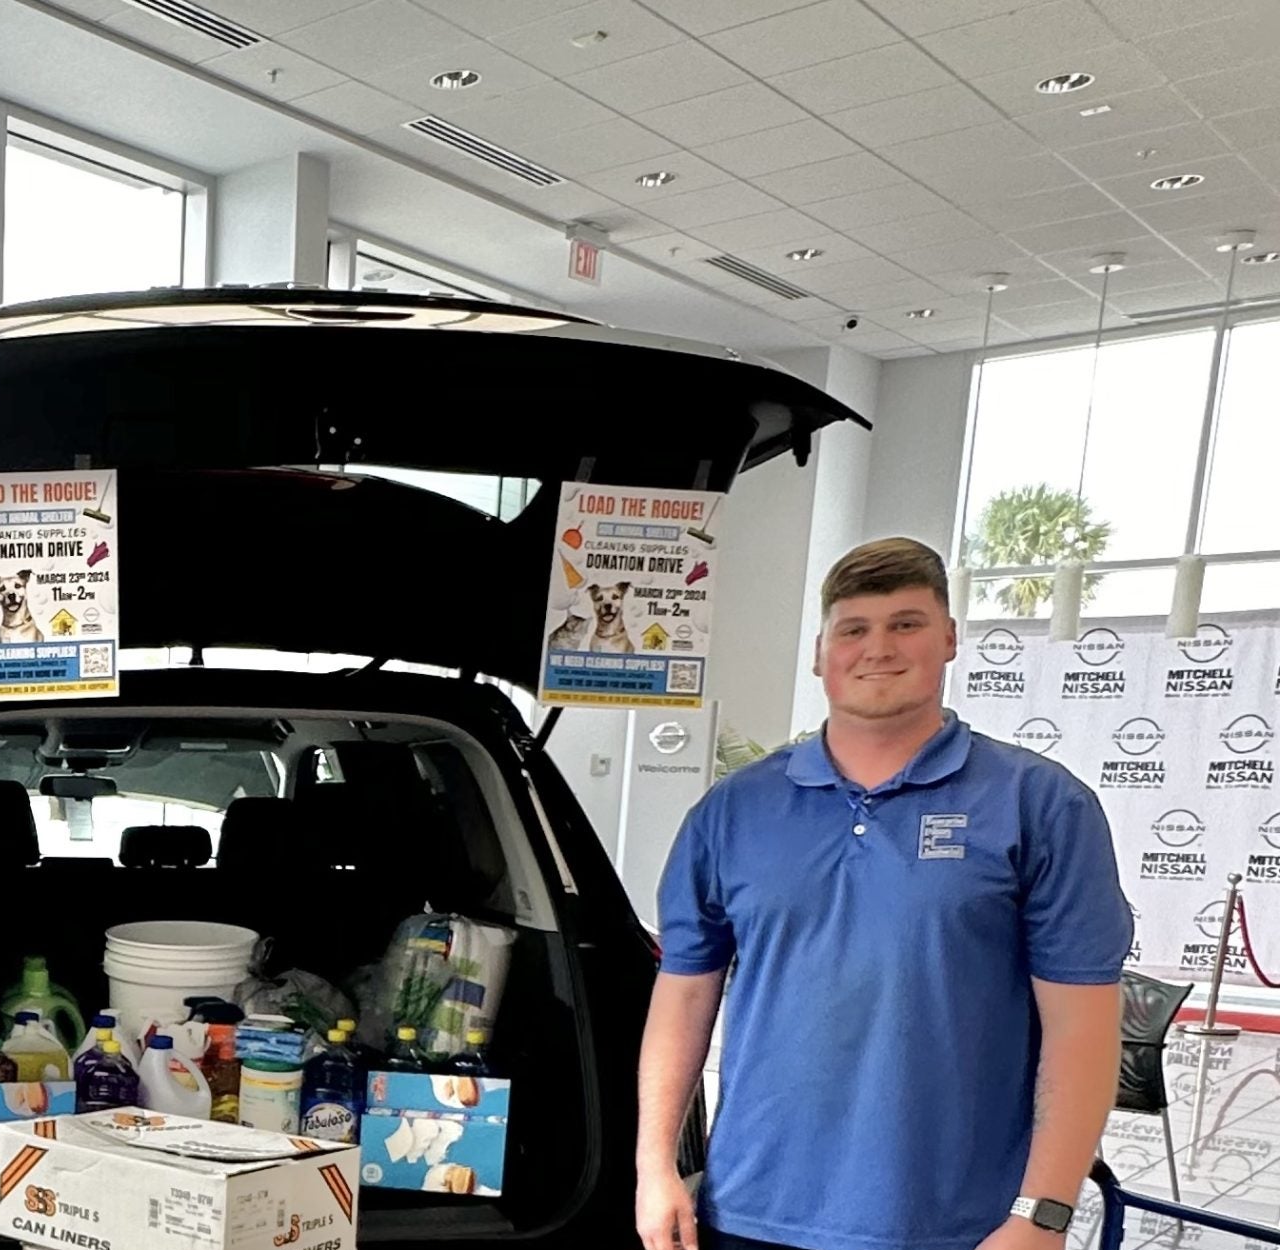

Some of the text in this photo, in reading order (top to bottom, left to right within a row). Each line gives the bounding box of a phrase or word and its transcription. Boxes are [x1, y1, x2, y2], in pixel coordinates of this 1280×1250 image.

[10, 483, 38, 503] THE
[43, 481, 97, 502] ROGUE!
[579, 494, 704, 520] LOAD THE ROGUE!
[37, 528, 87, 538] SUPPLIES
[48, 541, 83, 557] DRIVE
[584, 540, 688, 555] CLEANING SUPPLIES
[586, 554, 684, 574] DONATION DRIVE
[36, 573, 66, 584] MARCH
[87, 571, 109, 582] 2024
[634, 587, 663, 599] MARCH
[1073, 642, 1125, 650] NISSAN
[1177, 639, 1233, 647] NISSAN
[968, 671, 1025, 682] MITCHELL
[1064, 671, 1126, 681] MITCHELL
[1168, 668, 1234, 680] MITCHELL
[967, 681, 1024, 693] NISSAN
[1062, 682, 1125, 693] NISSAN
[1165, 680, 1233, 692] NISSAN
[1013, 732, 1062, 740] NISSAN
[1219, 730, 1274, 739] NISSAN
[638, 763, 700, 774] Welcome
[1102, 761, 1165, 771] MITCHELL
[1209, 760, 1274, 772] MITCHELL
[1100, 772, 1165, 784] NISSAN
[1207, 772, 1273, 783] NISSAN
[1151, 824, 1206, 832] NISSAN
[1142, 852, 1206, 864] MITCHELL
[1141, 863, 1206, 875] NISSAN
[302, 1111, 352, 1132] Fabuloso
[58, 1202, 90, 1220] TRIPLE
[93, 1211, 100, 1222] S
[12, 1217, 46, 1236] CAN
[302, 1214, 333, 1232] TRIPLE S
